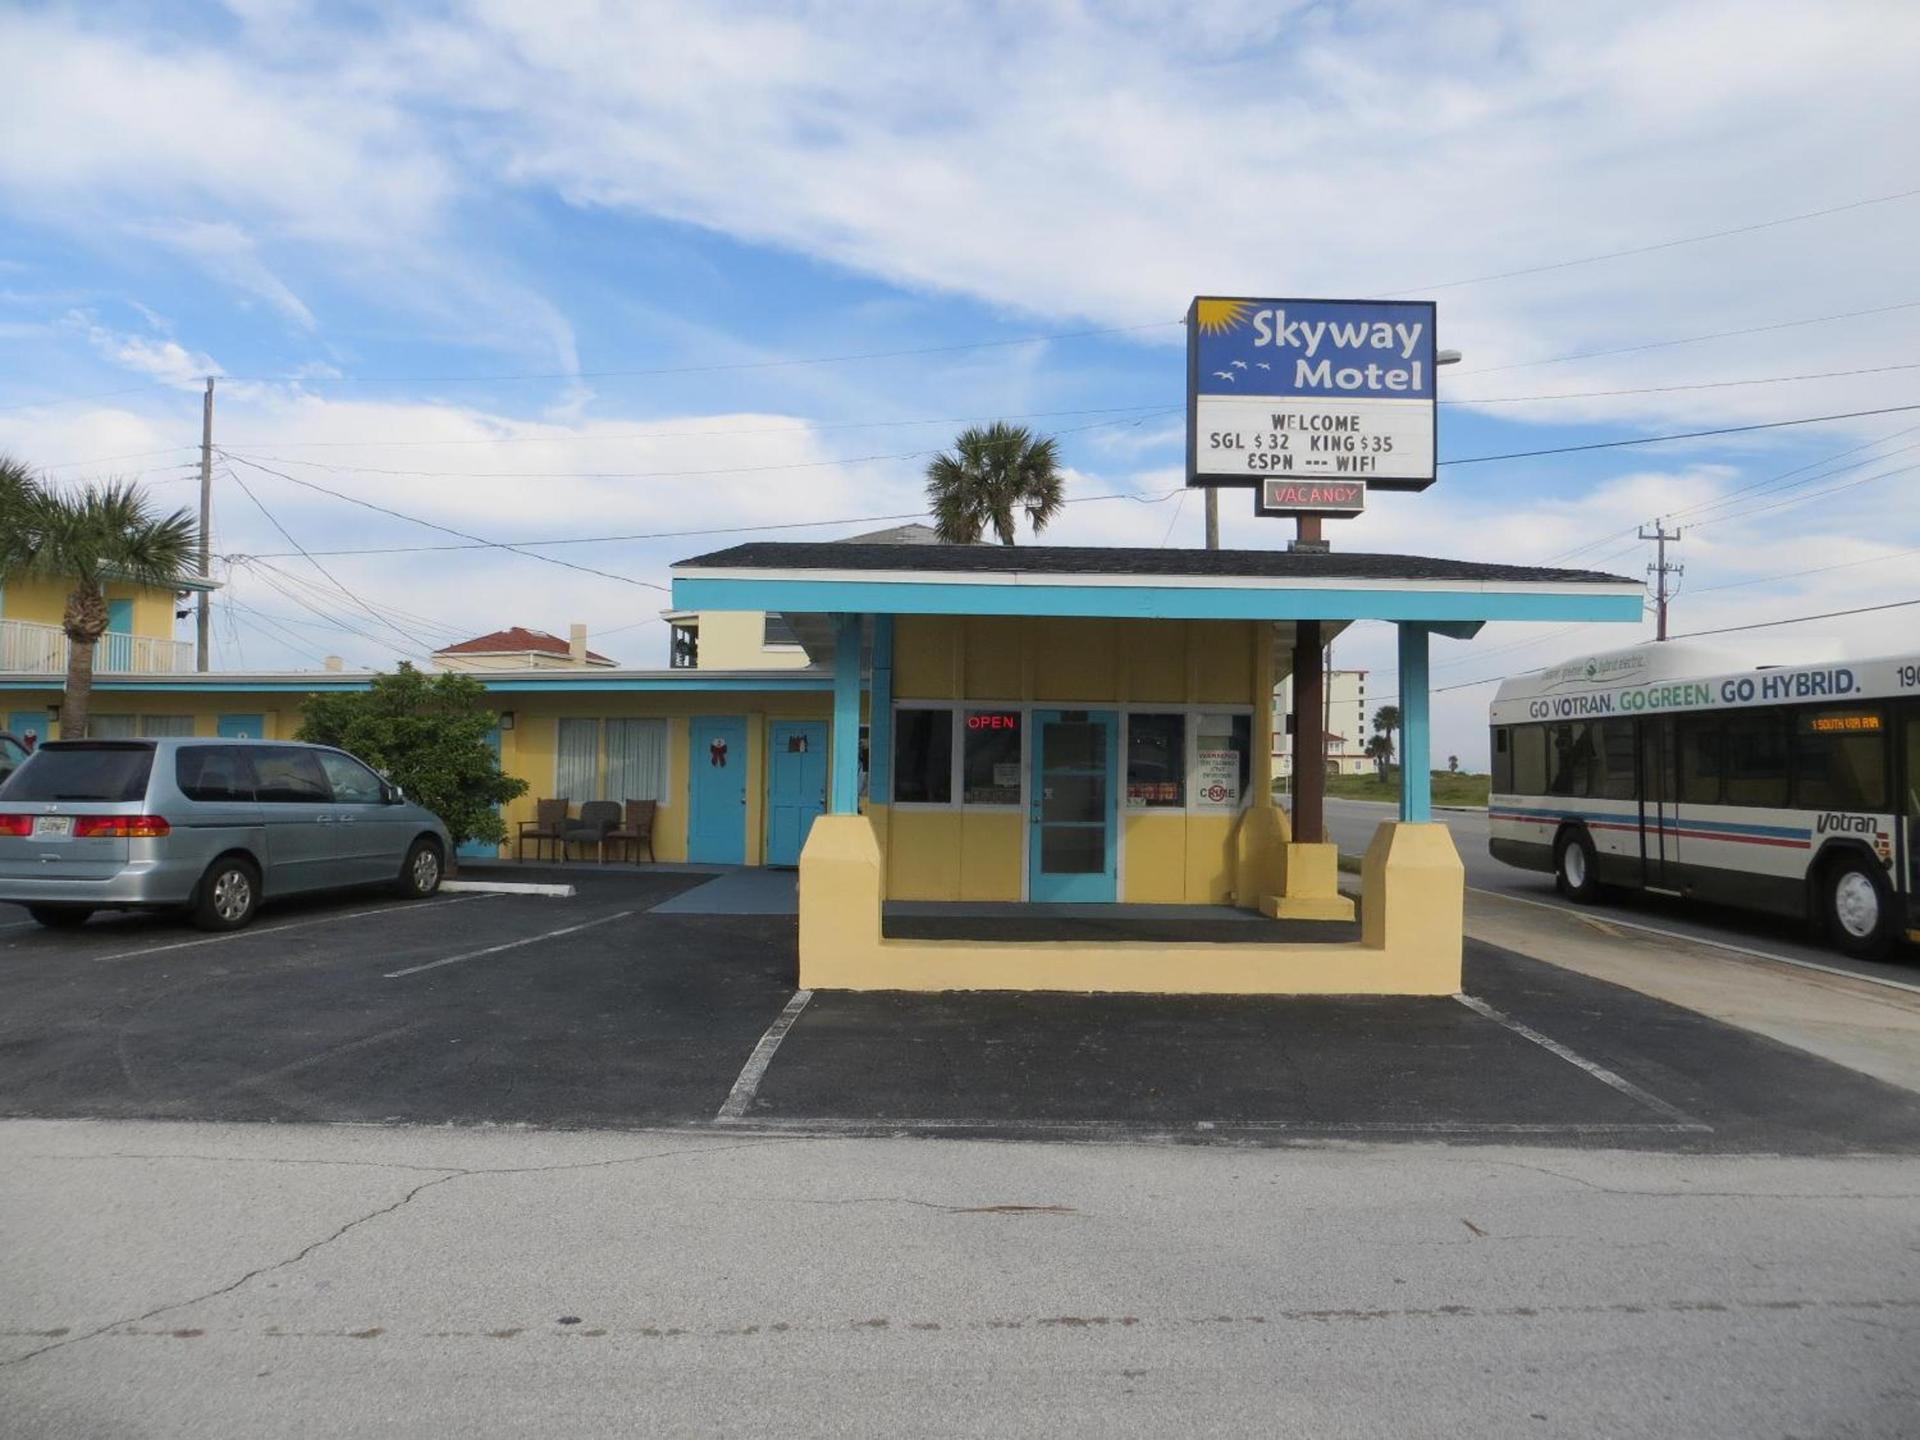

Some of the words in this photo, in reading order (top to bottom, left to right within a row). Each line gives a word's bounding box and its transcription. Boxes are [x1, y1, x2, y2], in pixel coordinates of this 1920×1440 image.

[1252, 309, 1423, 359] Skyway
[1294, 359, 1423, 391] Motel
[1271, 414, 1360, 432] WELCOME
[1210, 432, 1245, 449] SGL
[1310, 435, 1355, 452] KING
[1247, 452, 1293, 470] ESPN
[1336, 456, 1375, 472] WIFI
[1274, 487, 1357, 503] VACANCY
[1530, 700, 1550, 719] GO
[1553, 693, 1615, 717] VOTRAN.
[1620, 690, 1645, 711] GO
[1647, 683, 1715, 709] GREEN.
[1720, 678, 1755, 704] GO
[1762, 668, 1861, 700] HYBRID.
[967, 715, 1014, 729] OPEN
[1816, 812, 1878, 834] Votran
